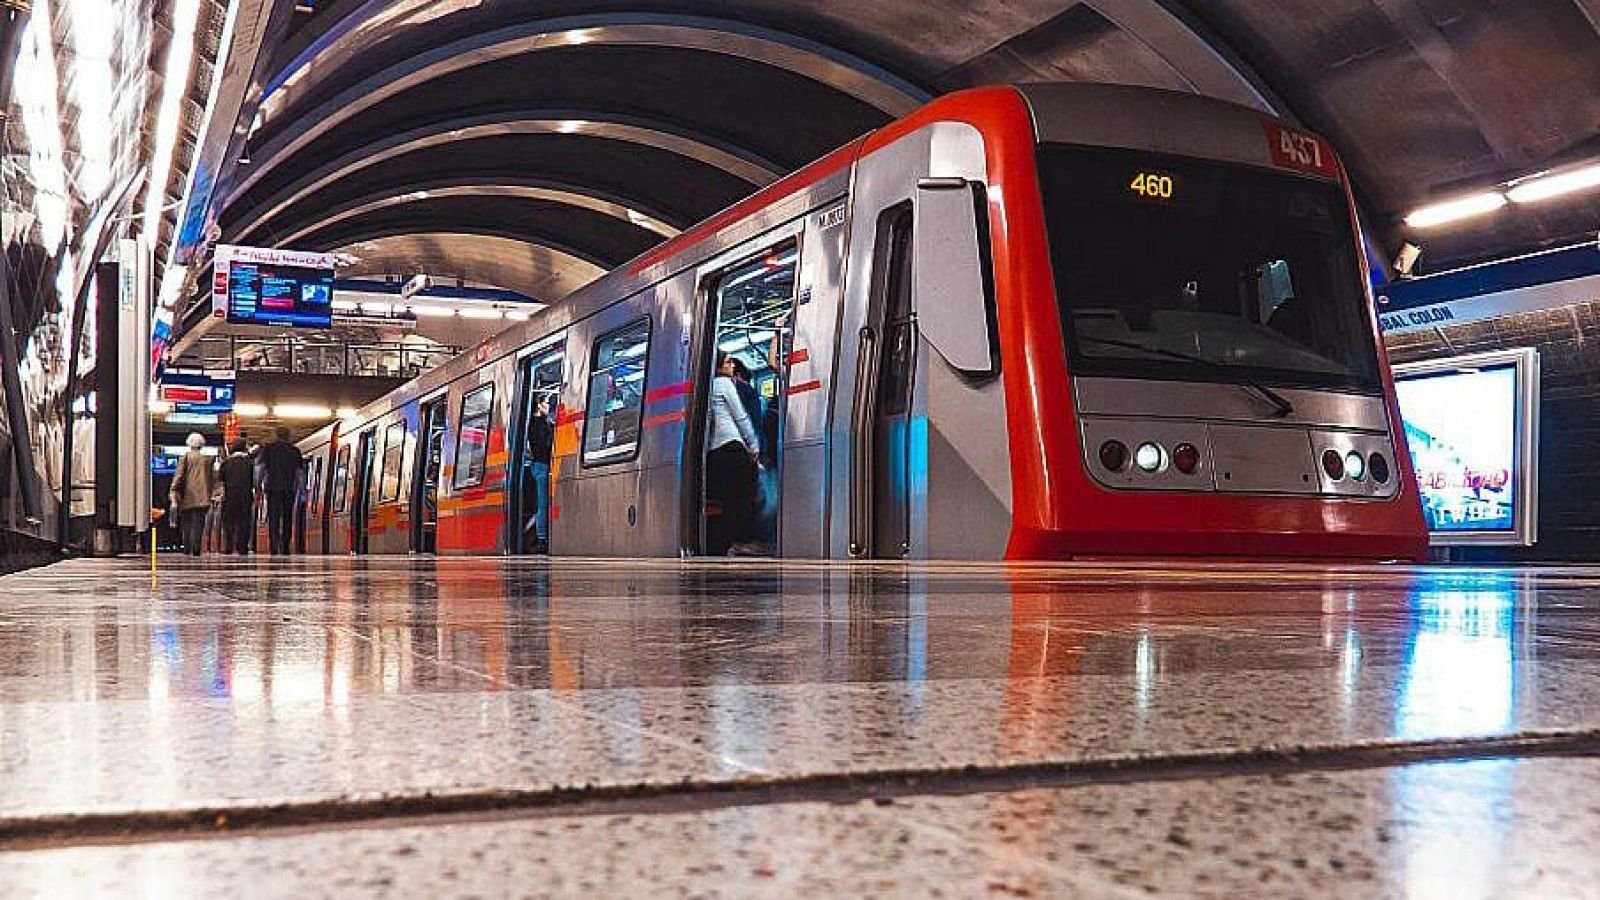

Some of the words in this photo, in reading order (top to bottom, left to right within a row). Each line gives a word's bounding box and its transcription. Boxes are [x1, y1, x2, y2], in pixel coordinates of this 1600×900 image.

[1280, 131, 1321, 167] 437
[1130, 173, 1172, 198] 460
[1380, 315, 1410, 331] BAL
